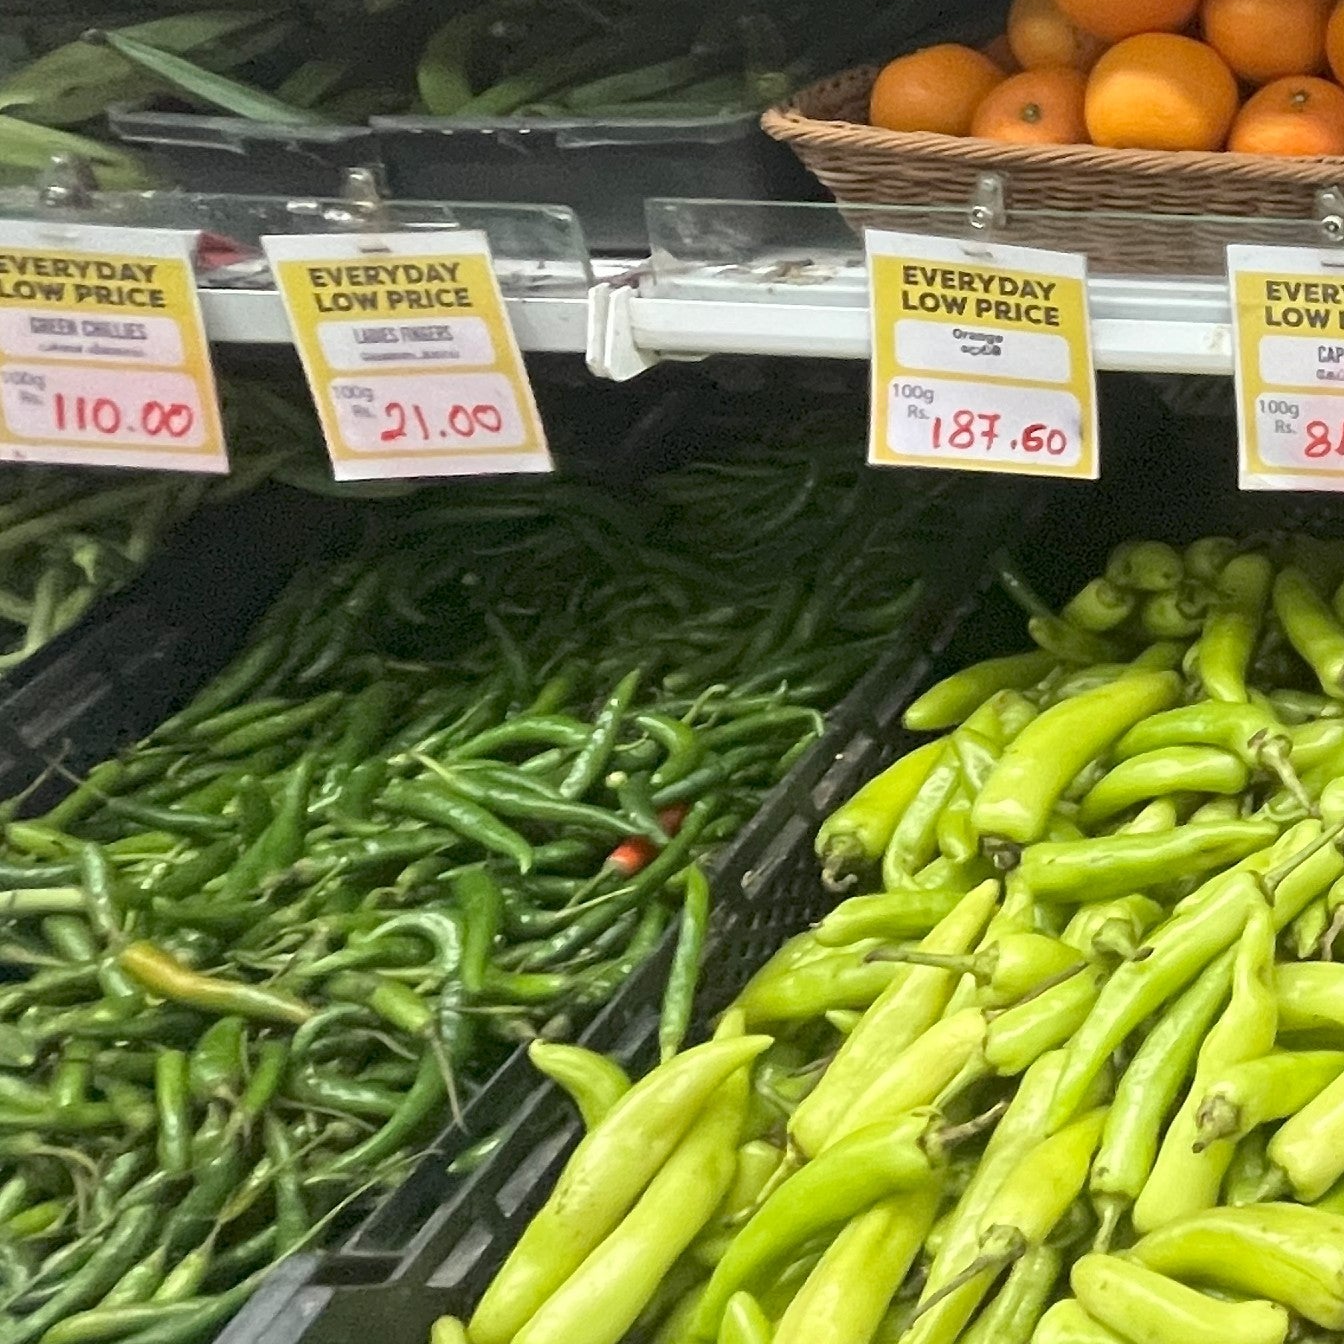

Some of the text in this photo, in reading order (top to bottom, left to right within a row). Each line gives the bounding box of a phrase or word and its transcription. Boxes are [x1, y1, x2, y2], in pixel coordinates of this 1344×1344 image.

[308, 262, 460, 288] EVERYDAY
[902, 265, 1056, 301] EVERYDAY
[74, 283, 166, 308] PRICE
[314, 288, 474, 313] LOW PRICE
[901, 291, 1060, 327] LOW PRICE
[1264, 306, 1331, 329] LOW
[952, 328, 1003, 345] Orange
[893, 383, 934, 404] 100g
[55, 392, 194, 438] 110.00
[381, 402, 501, 441] 21.00
[1259, 400, 1300, 419] 100g
[1274, 419, 1297, 434] Rs.
